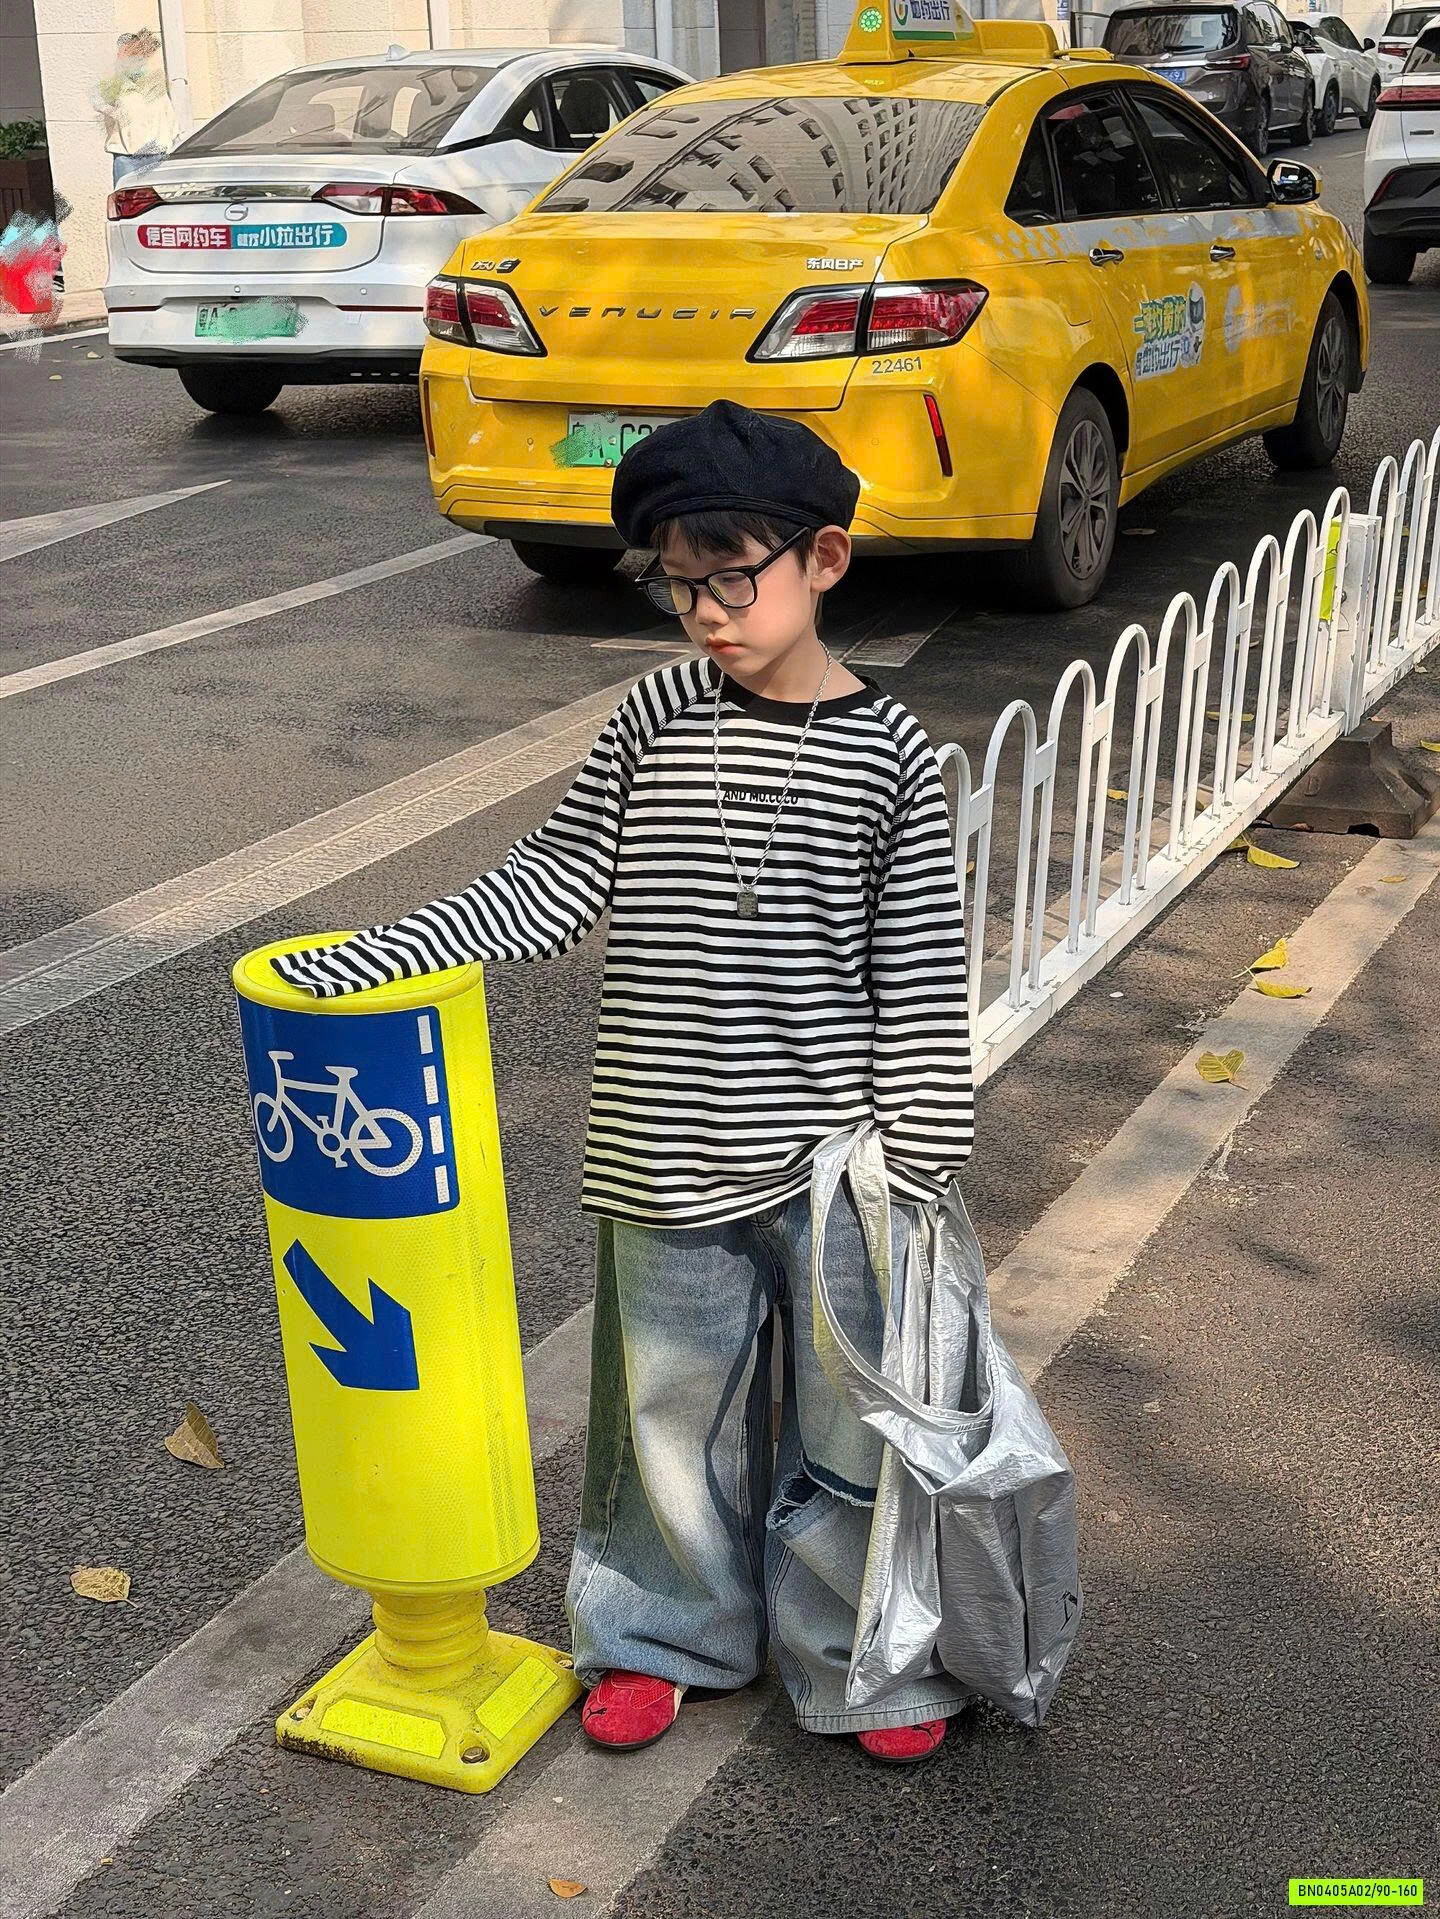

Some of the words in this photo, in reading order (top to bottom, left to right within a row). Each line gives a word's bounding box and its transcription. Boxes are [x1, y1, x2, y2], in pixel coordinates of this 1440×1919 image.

[146, 227, 228, 247] 便宜网约车
[806, 258, 864, 270] 东风日产
[538, 305, 758, 320] VENUCIA
[872, 356, 922, 374] 22461
[723, 790, 747, 801] AND
